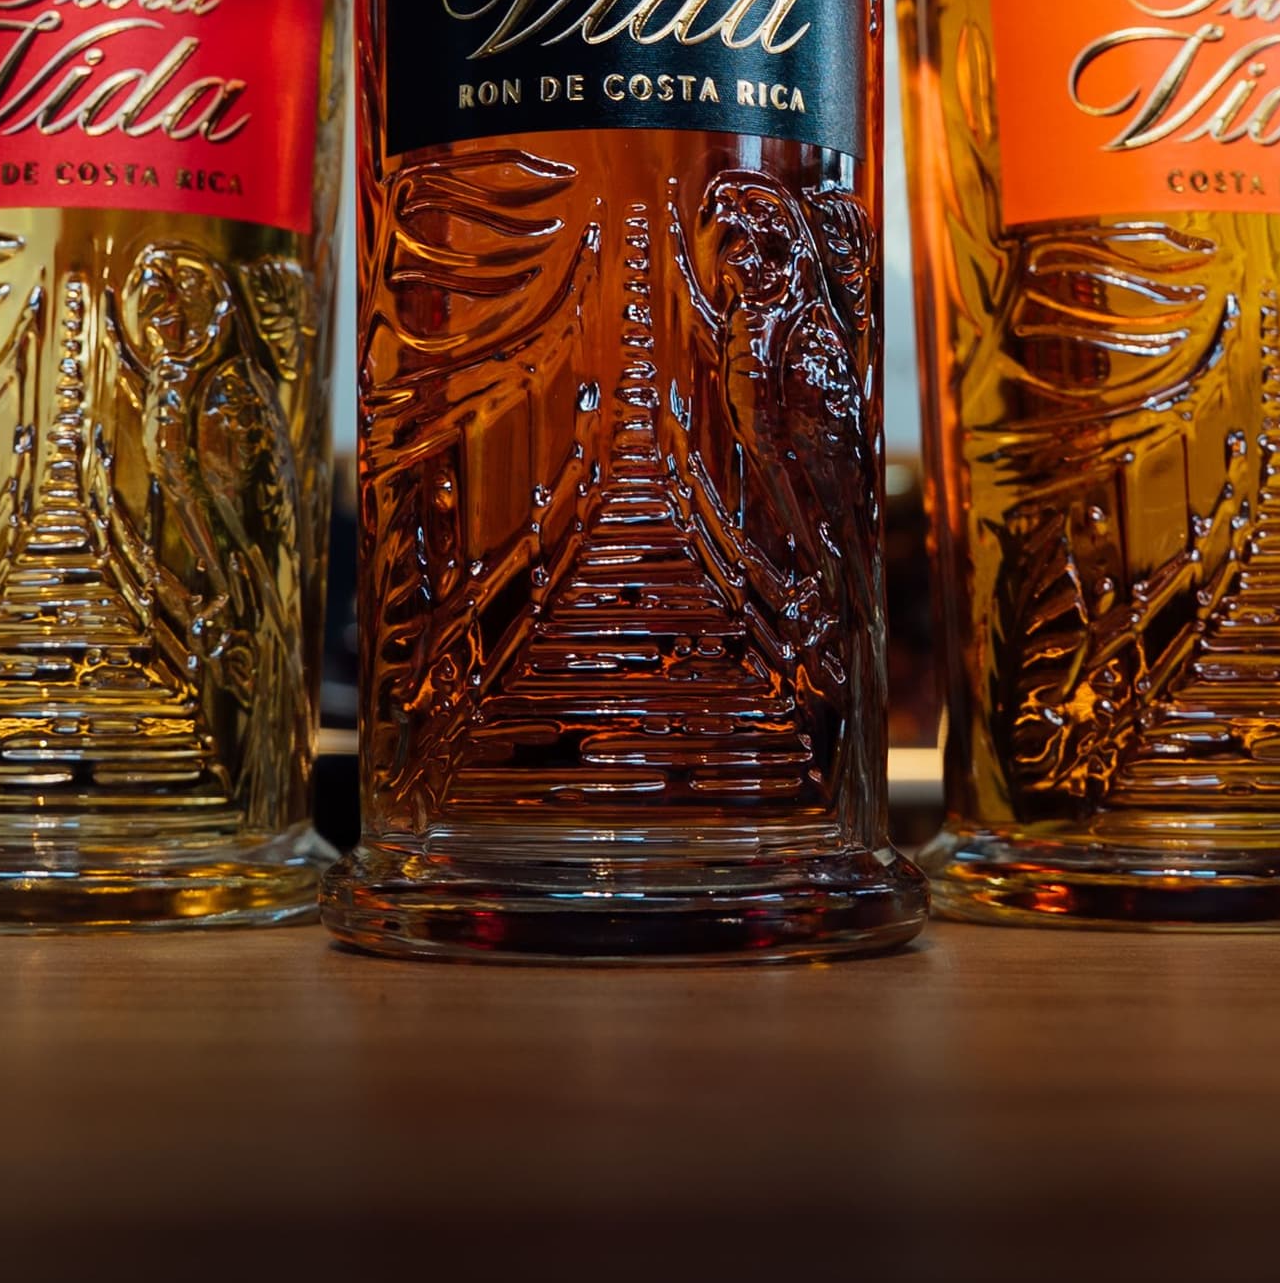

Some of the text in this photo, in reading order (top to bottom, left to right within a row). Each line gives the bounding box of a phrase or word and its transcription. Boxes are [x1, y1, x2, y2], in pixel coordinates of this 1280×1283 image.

[458, 73, 806, 113] RON DE COSTA RICA
[1, 162, 39, 185] DE
[55, 162, 160, 187] COSTA
[175, 168, 244, 196] RICA
[1167, 168, 1266, 195] COSTA
